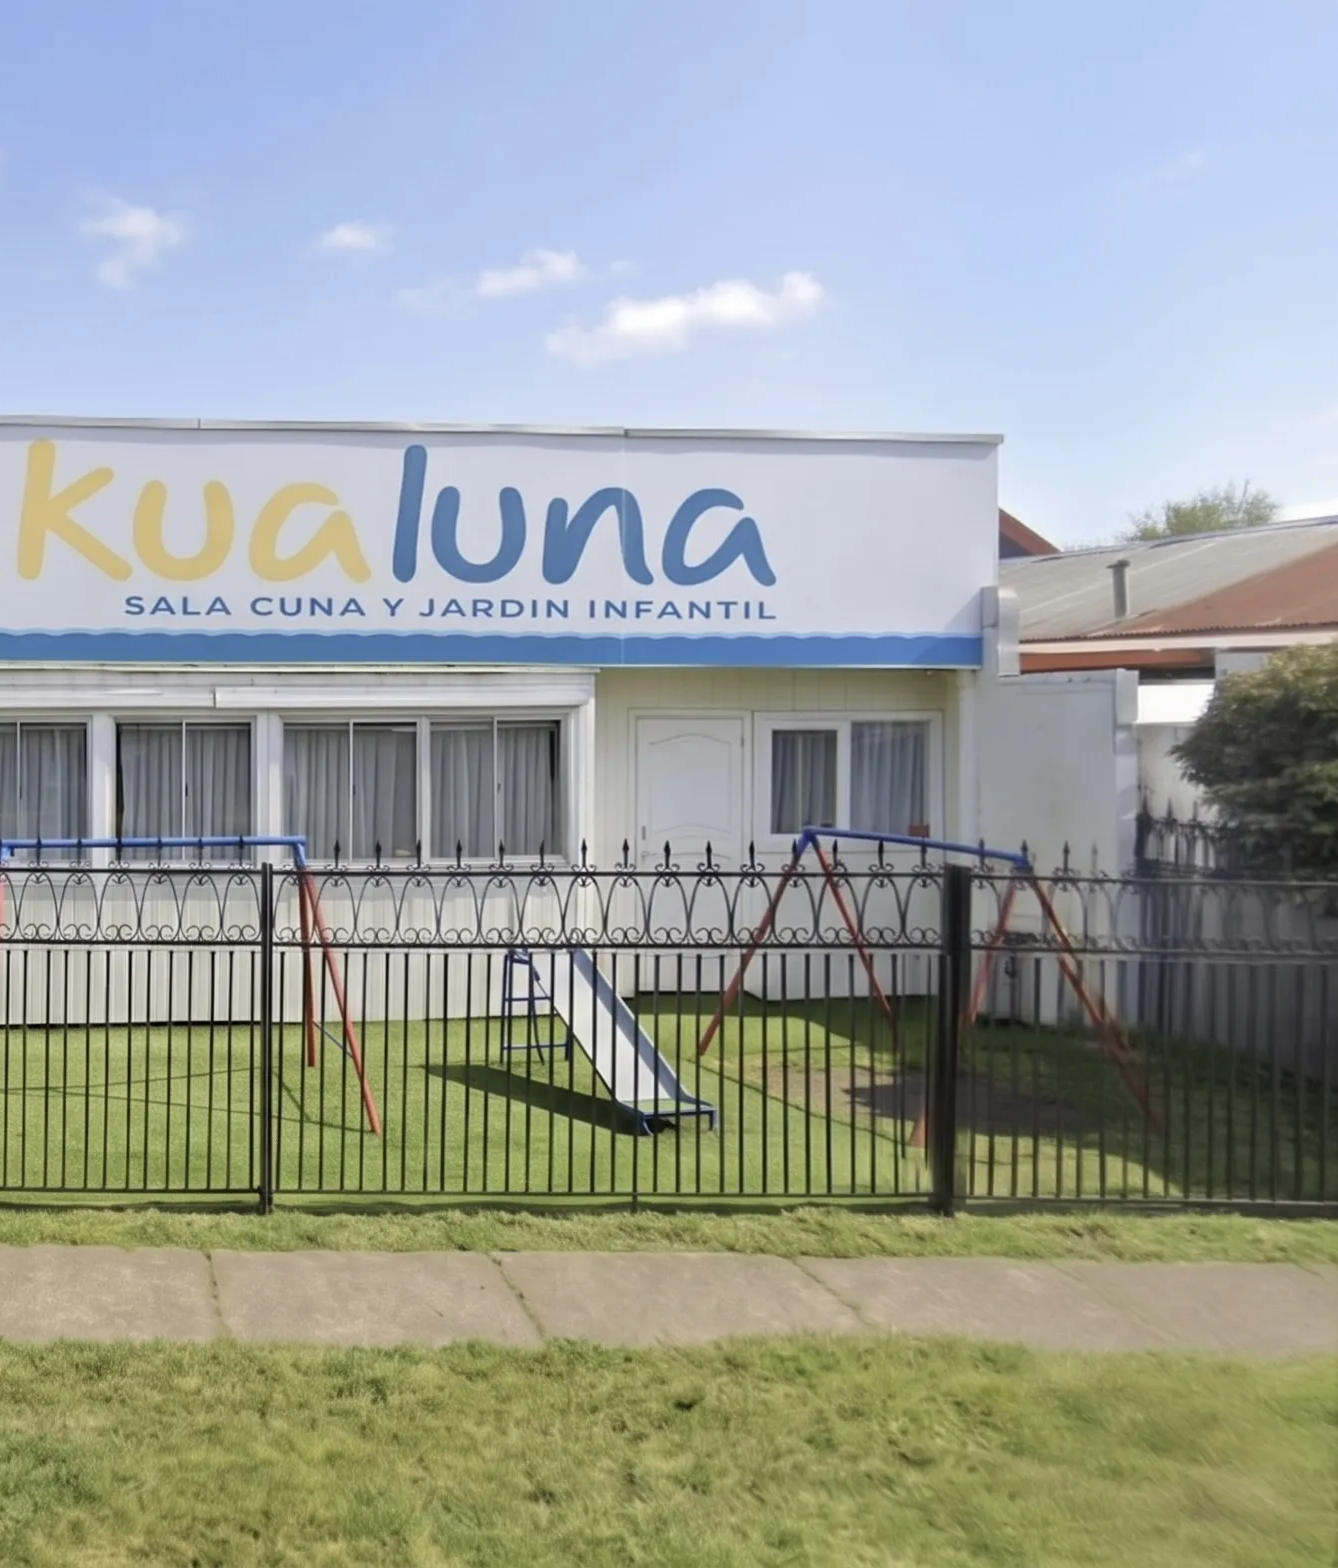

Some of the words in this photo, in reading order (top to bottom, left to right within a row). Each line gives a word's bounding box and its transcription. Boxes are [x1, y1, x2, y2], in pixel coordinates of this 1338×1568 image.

[124, 595, 232, 616] SALA
[250, 596, 366, 617] CUNA
[382, 598, 404, 617] Y
[419, 598, 569, 619] JARDIN
[589, 599, 777, 620] INFANTIL
